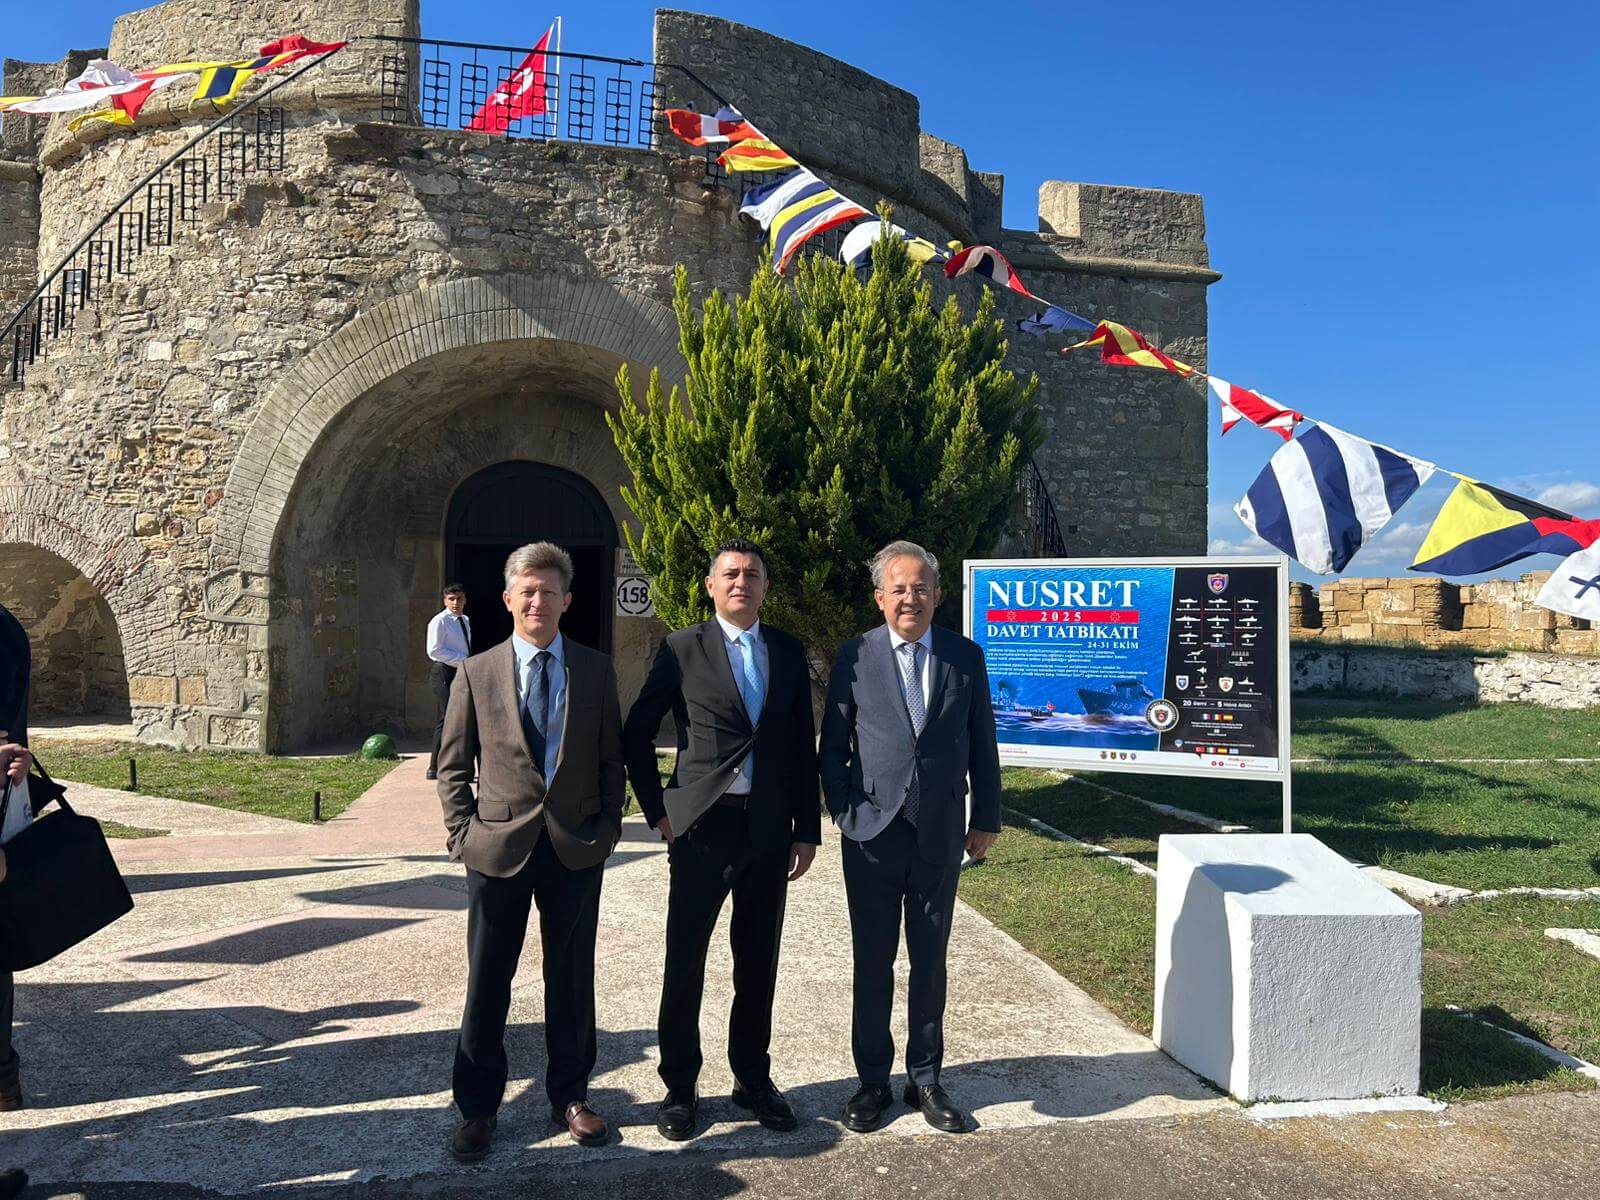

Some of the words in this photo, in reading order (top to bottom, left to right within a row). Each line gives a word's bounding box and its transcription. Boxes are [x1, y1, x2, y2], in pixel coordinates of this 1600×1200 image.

[622, 586, 649, 604] 158
[987, 580, 1140, 608] NUSRET
[1040, 611, 1082, 622] 2025
[987, 624, 1042, 638] DAVET
[1044, 623, 1139, 640] TATBİKATI
[1087, 641, 1110, 649] 24-31
[1113, 640, 1139, 649] EKİM
